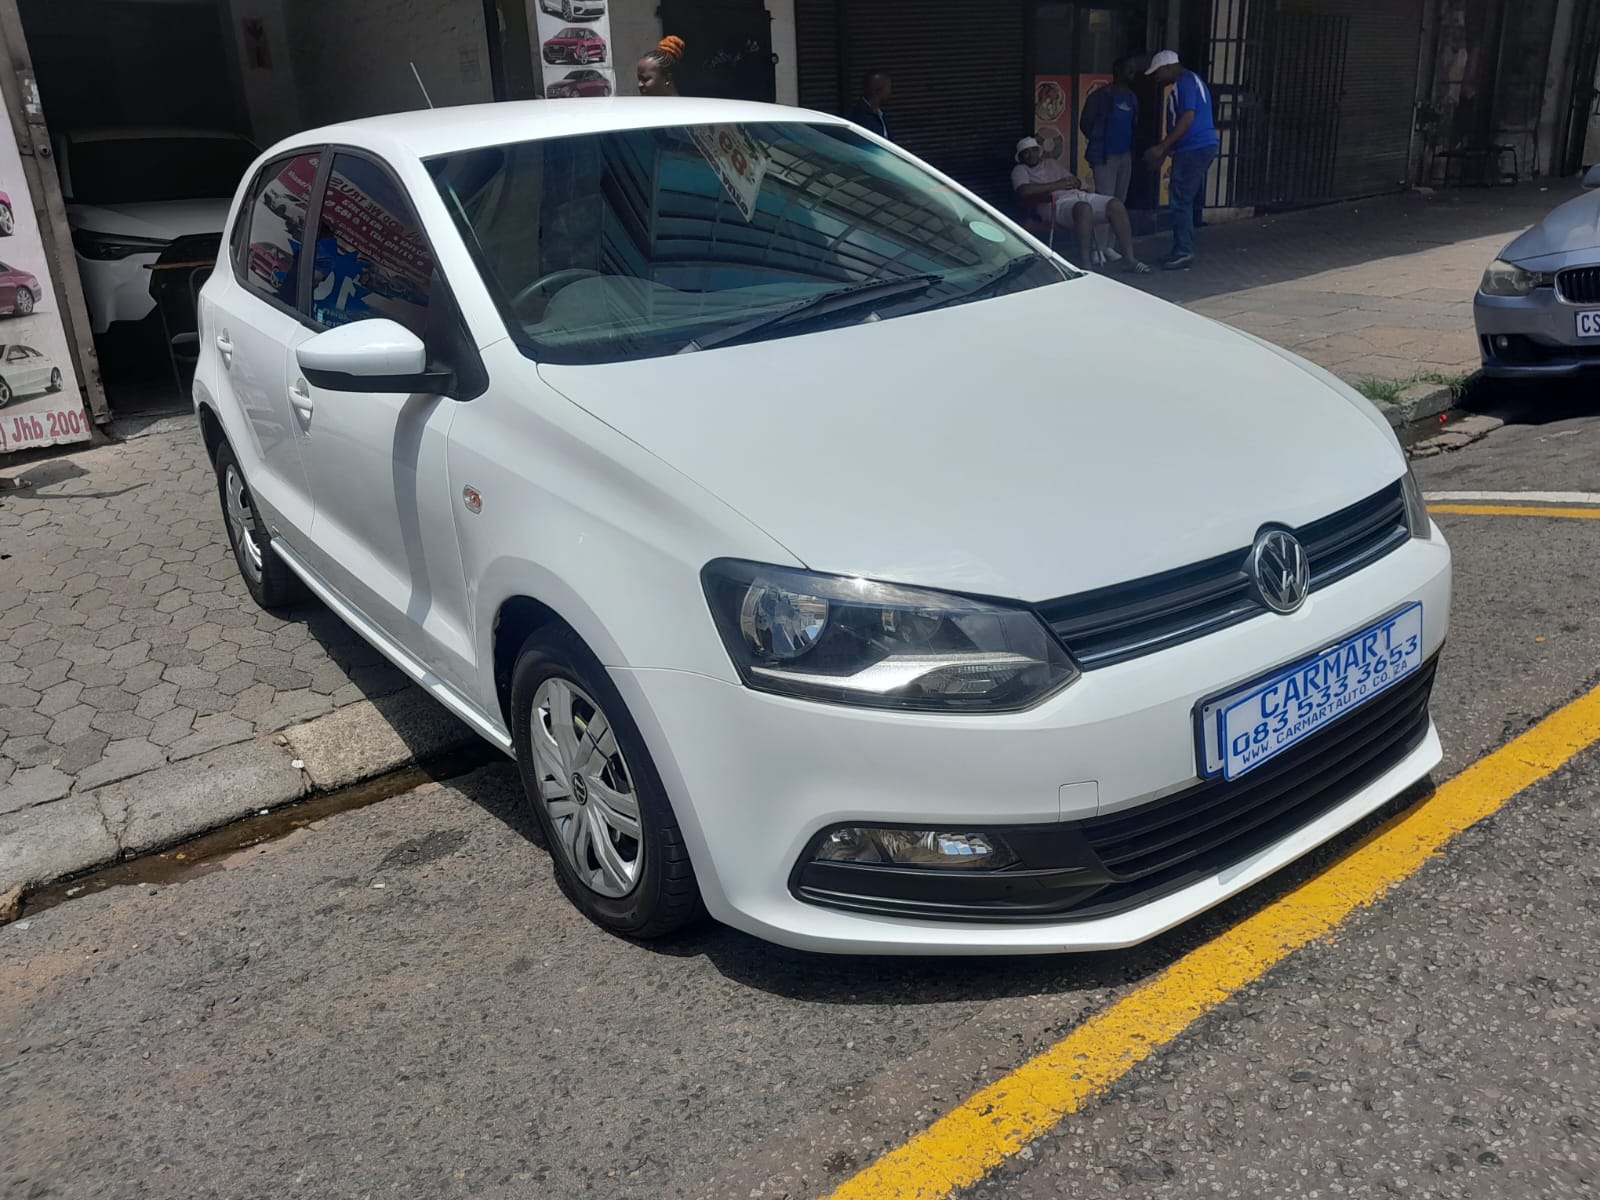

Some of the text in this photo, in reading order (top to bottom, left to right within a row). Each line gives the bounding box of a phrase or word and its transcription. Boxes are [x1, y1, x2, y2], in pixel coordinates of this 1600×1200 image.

[12, 415, 44, 443] Jhb
[46, 409, 90, 438] 2001
[1232, 709, 1289, 757] 083
[1297, 675, 1349, 719] 533
[1356, 634, 1419, 685] 3653
[1260, 621, 1397, 720] CARMART
